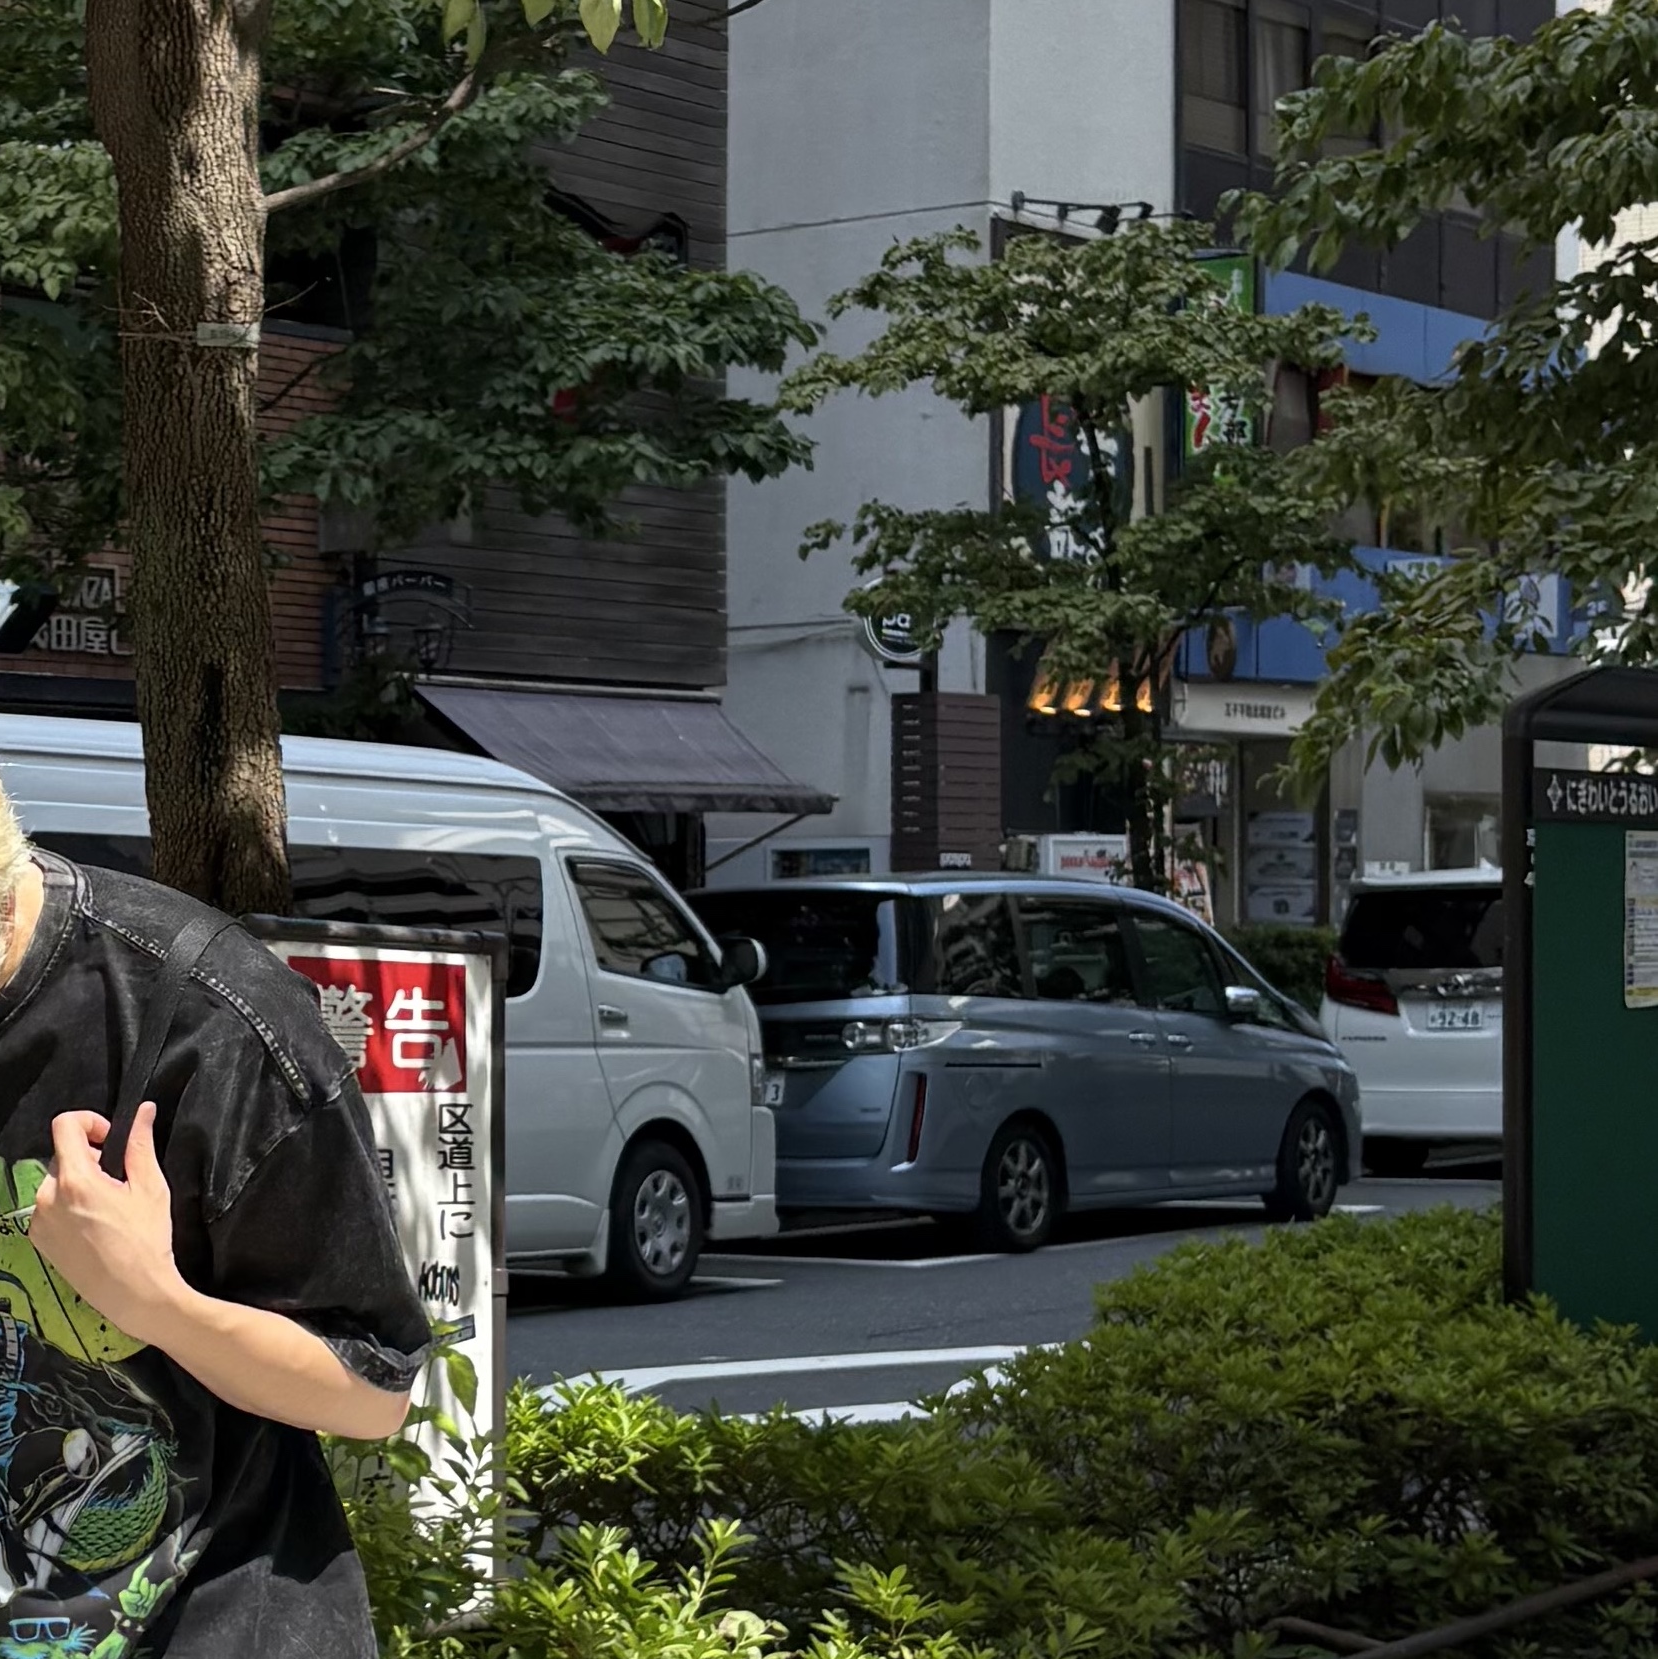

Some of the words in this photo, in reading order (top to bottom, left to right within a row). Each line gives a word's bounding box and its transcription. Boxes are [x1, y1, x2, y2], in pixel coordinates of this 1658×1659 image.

[321, 983, 450, 1069] 警告
[437, 1102, 476, 1241] 区道上に
